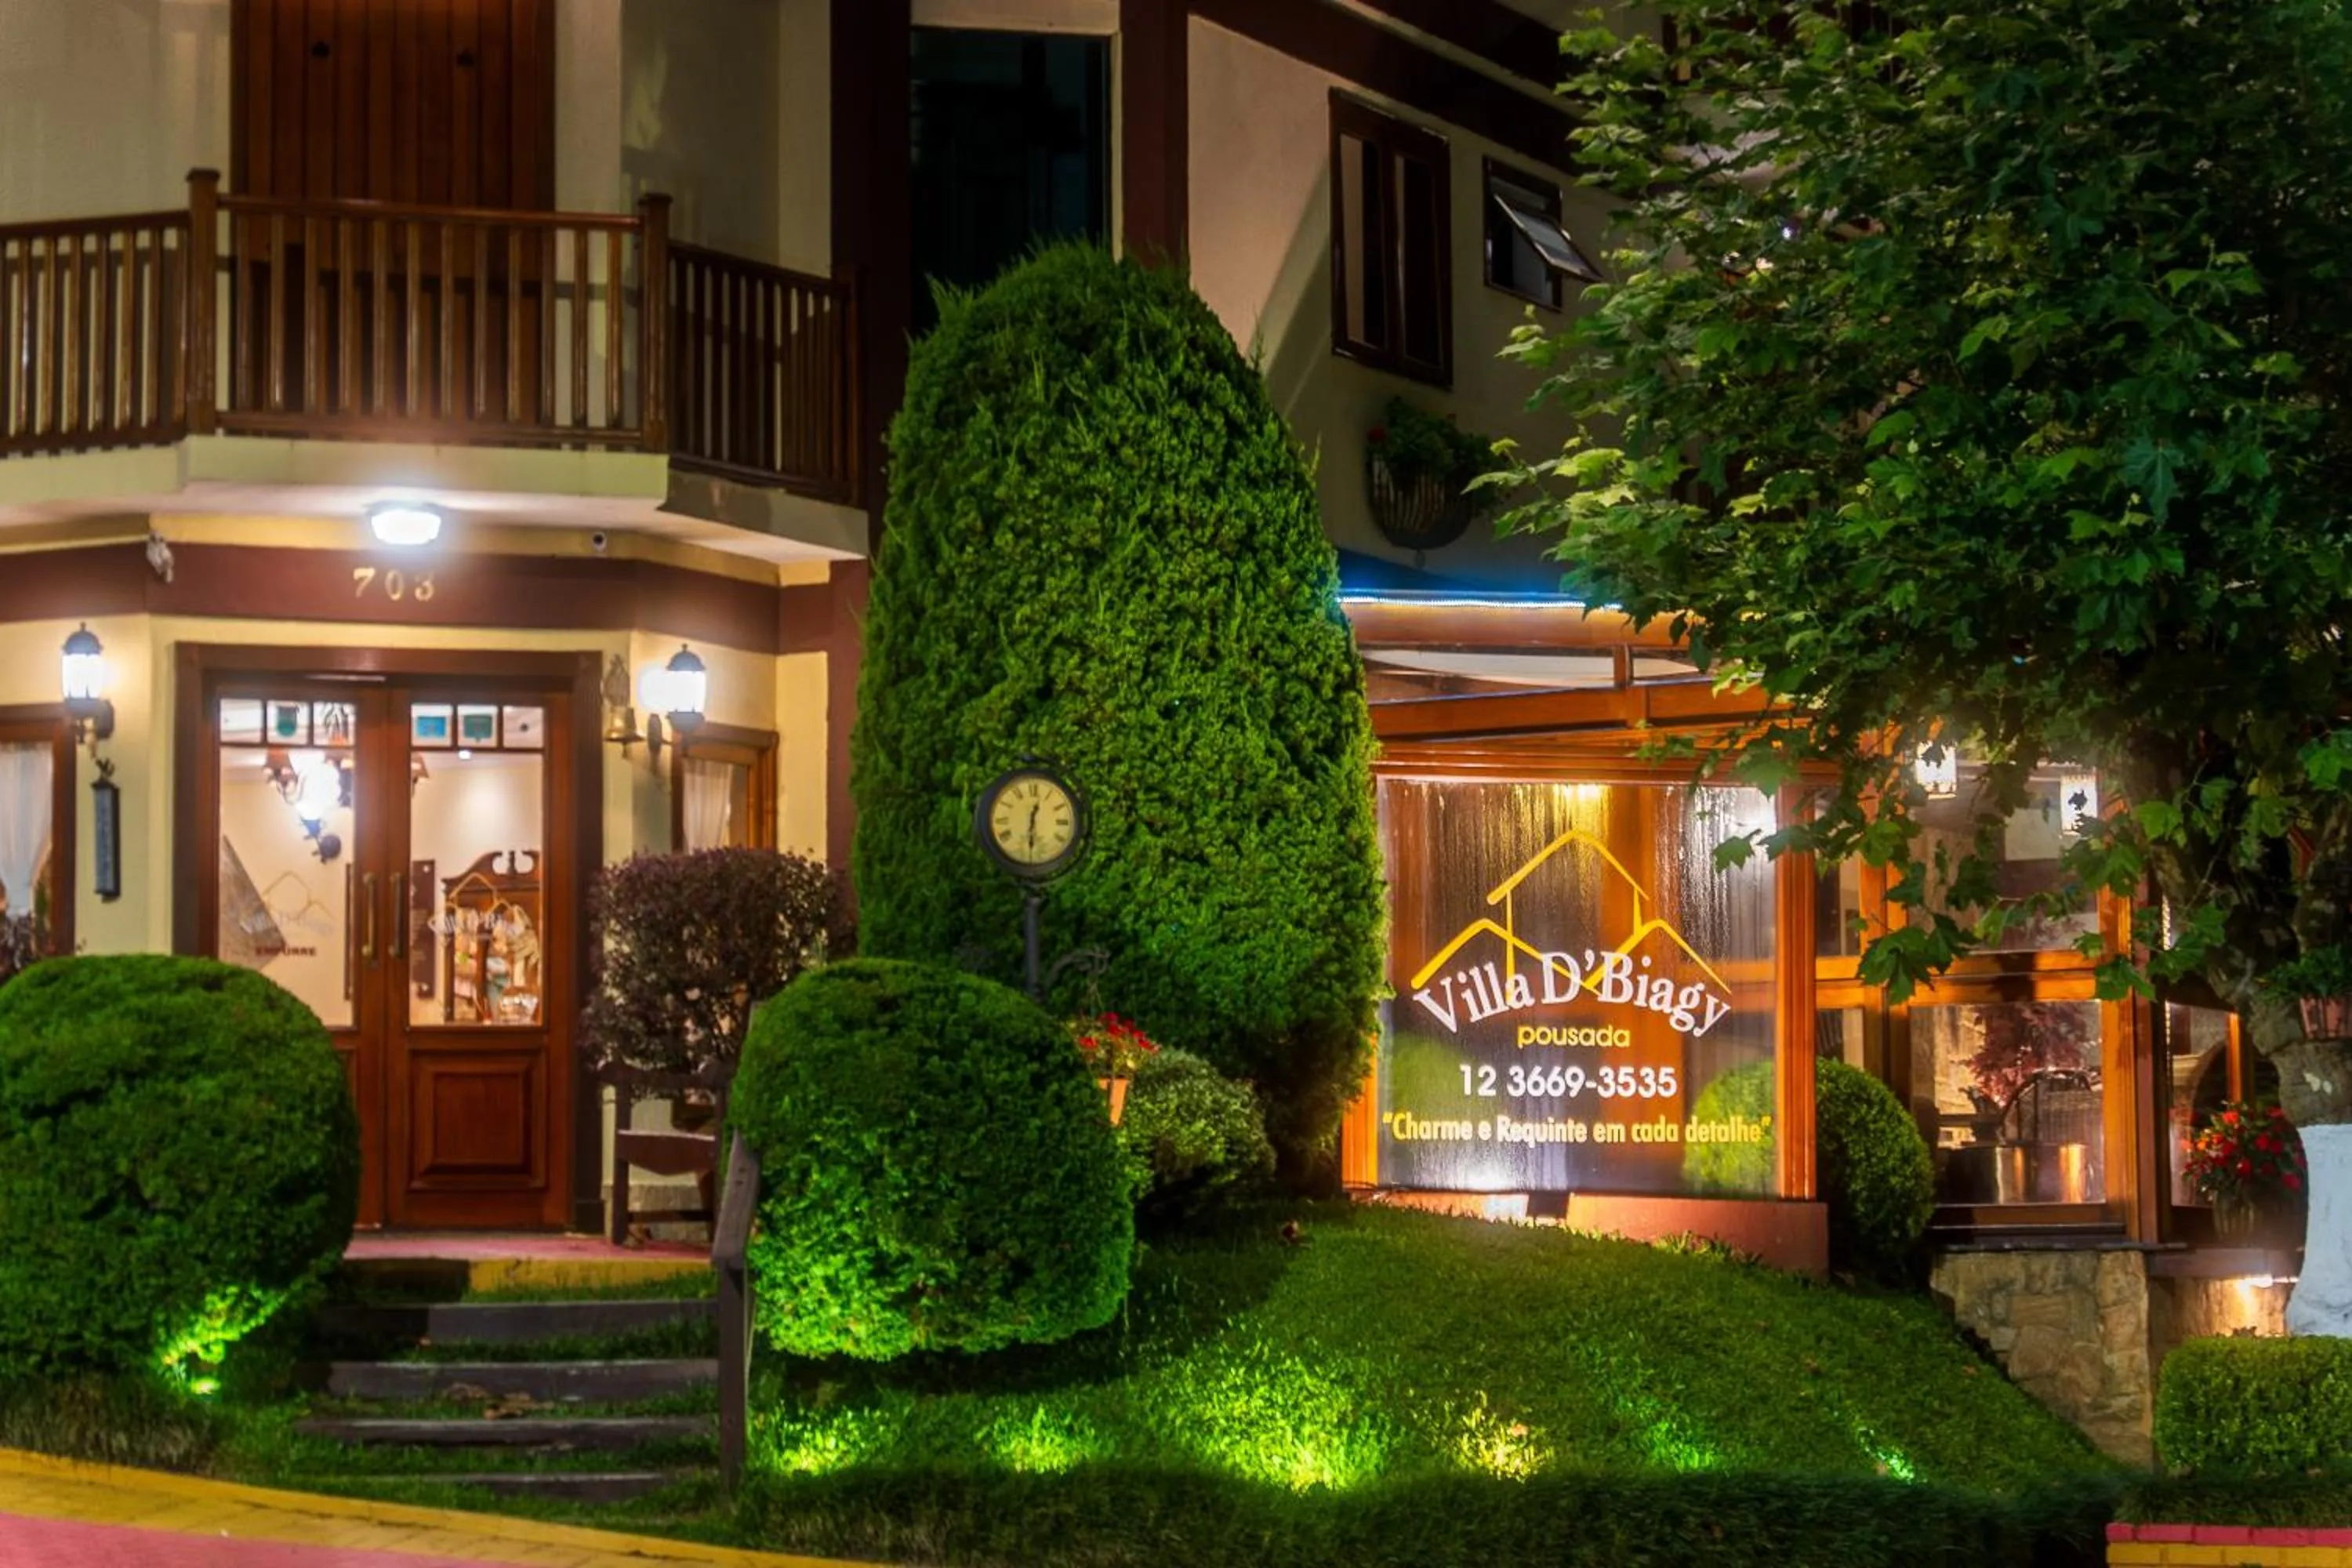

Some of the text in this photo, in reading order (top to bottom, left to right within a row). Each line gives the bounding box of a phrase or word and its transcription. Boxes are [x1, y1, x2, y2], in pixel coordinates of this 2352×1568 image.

[1412, 949, 1731, 1037] Villa D'Biagy
[1517, 1024, 1631, 1049] pousada
[1459, 1063, 1678, 1098] 12 3669-3535
[1477, 1121, 1492, 1141] e
[1497, 1114, 1588, 1149] Requinte
[1592, 1121, 1626, 1142] em
[1632, 1113, 1679, 1142] cada
